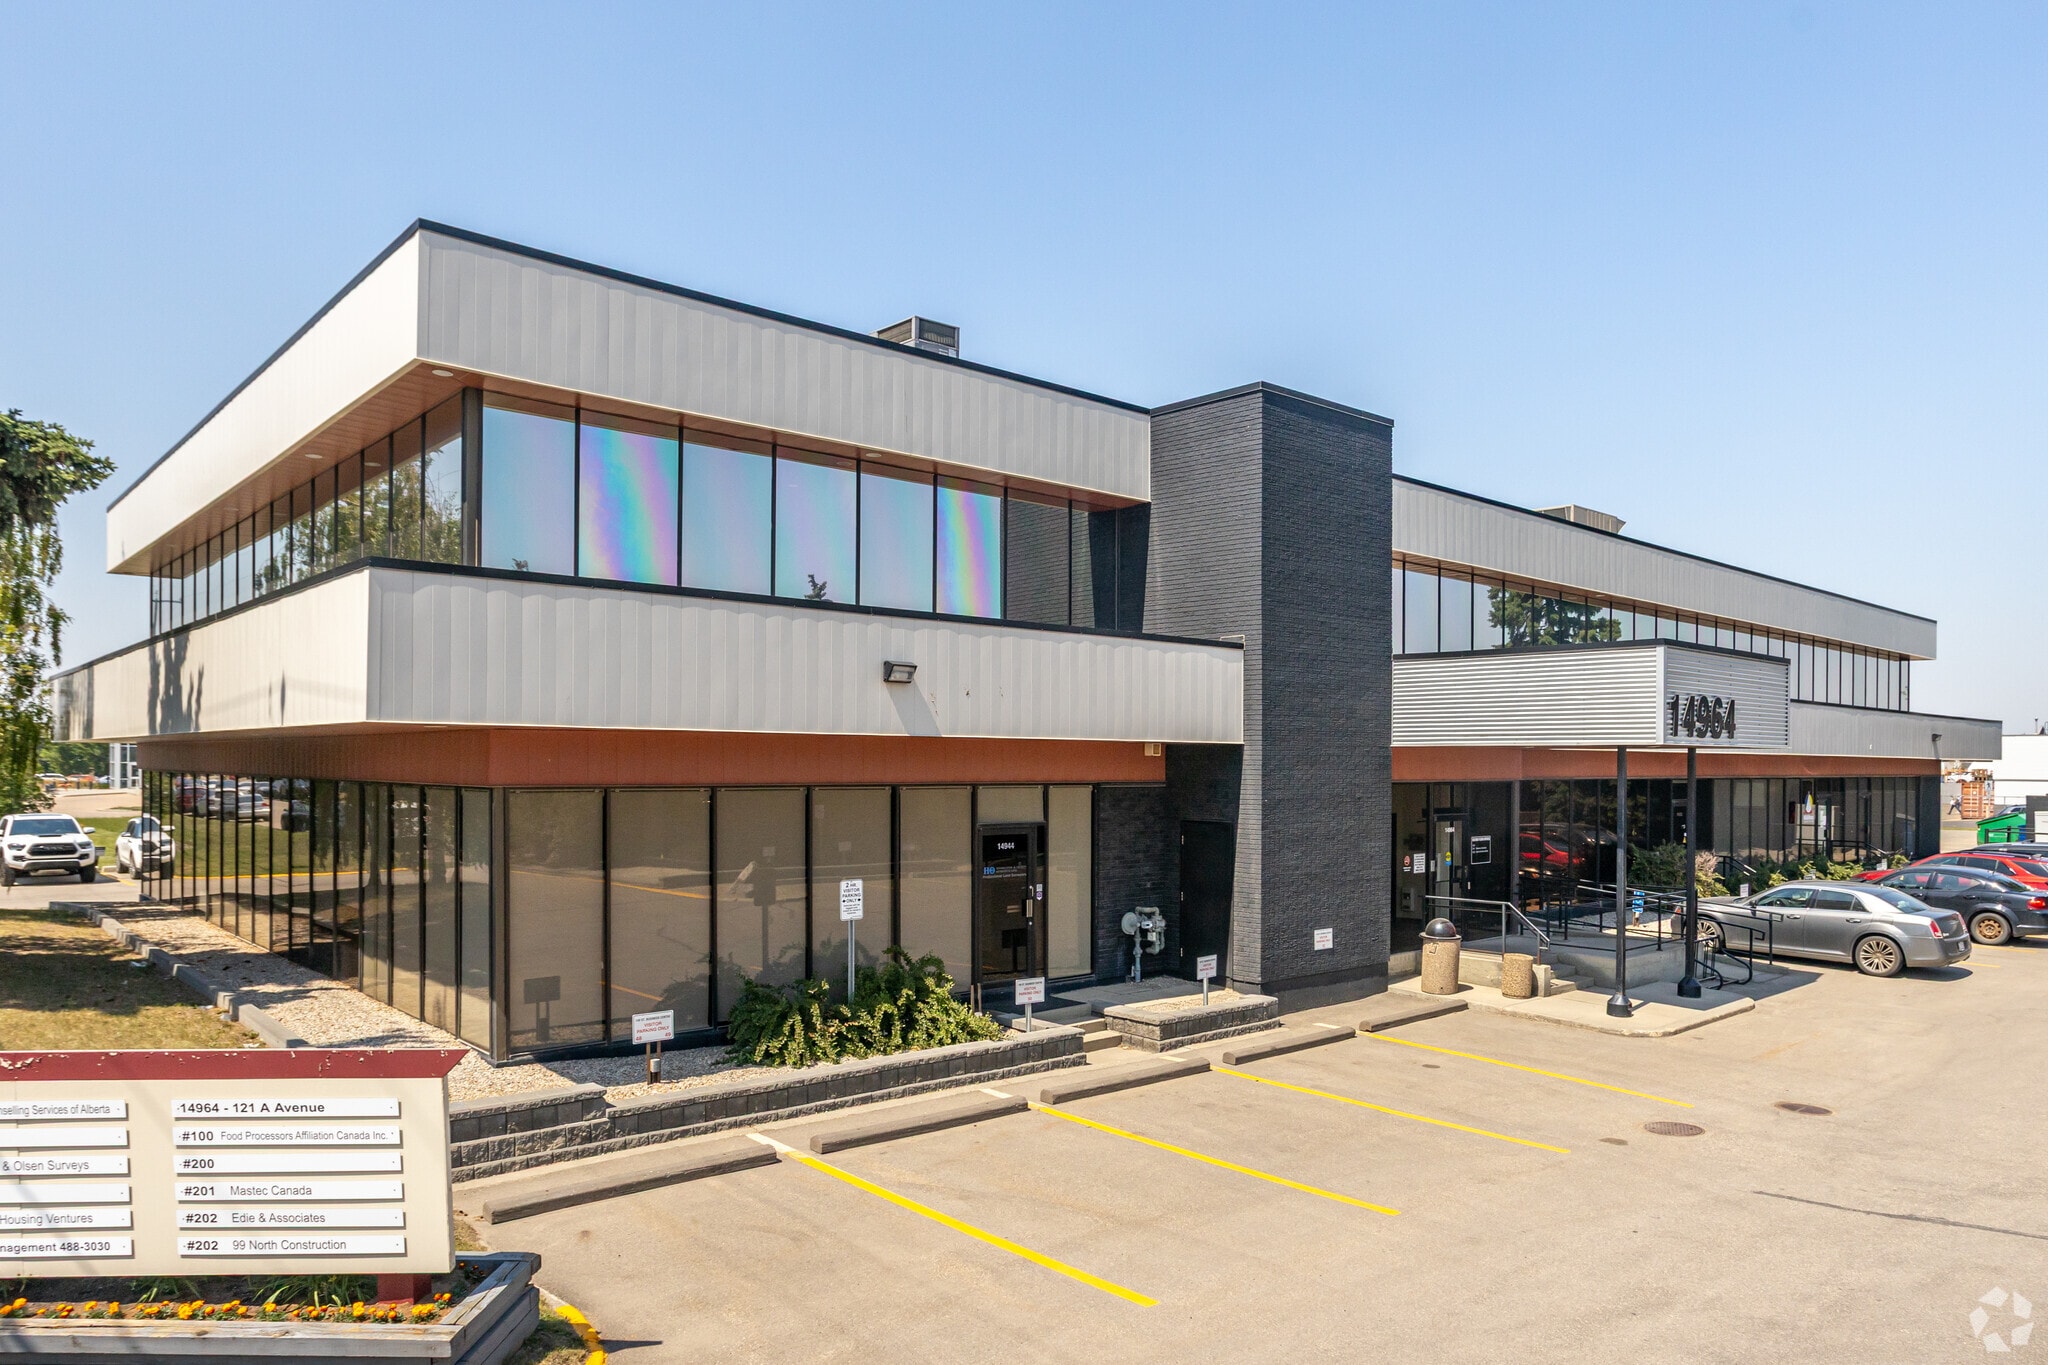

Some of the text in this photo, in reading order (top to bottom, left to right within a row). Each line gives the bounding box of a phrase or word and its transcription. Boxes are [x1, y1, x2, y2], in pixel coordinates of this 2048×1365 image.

[1667, 694, 1736, 739] 14964
[997, 842, 1015, 850] 14944
[31, 1104, 71, 1115] Services
[71, 1103, 80, 1114] of
[80, 1103, 111, 1115] Alberta
[180, 1103, 219, 1113] 14964
[233, 1103, 255, 1113] 121
[260, 1103, 270, 1112] A
[274, 1102, 325, 1112] Avenue
[182, 1130, 388, 1141] #100 Food Processors Affiliation Canada Inc.
[2, 1160, 90, 1173] & Olsen Surveys
[183, 1159, 215, 1169] #200
[184, 1185, 312, 1196] #201 Mastec Canada
[0, 1213, 94, 1227] Housing Ventures
[186, 1212, 326, 1223] #202 Edie & Associates
[0, 1241, 111, 1254] nagement 488-3030
[187, 1239, 347, 1251] #202 99 North Construction
